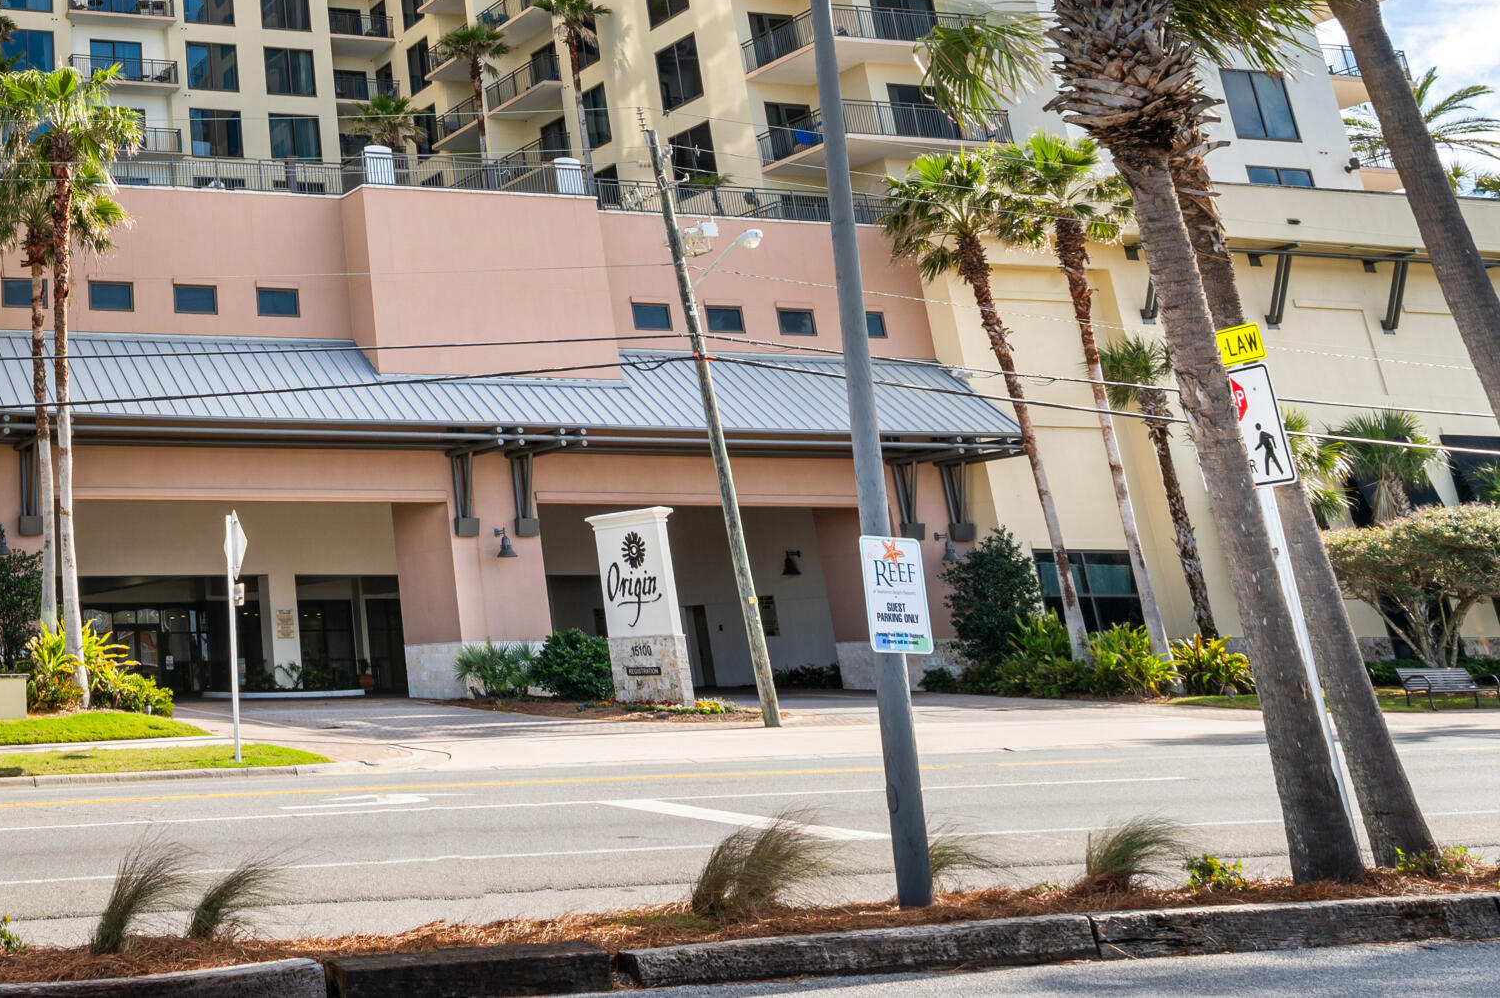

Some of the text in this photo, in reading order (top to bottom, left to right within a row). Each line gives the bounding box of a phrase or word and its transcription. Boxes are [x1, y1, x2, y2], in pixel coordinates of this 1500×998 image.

[1226, 332, 1258, 356] LAW
[873, 559, 916, 588] REEF
[607, 561, 662, 628] Origin
[886, 602, 906, 613] GUEST
[876, 612, 919, 624] PARKING ONLY
[631, 645, 652, 656] 15100
[628, 667, 659, 675] REGISTRATION
